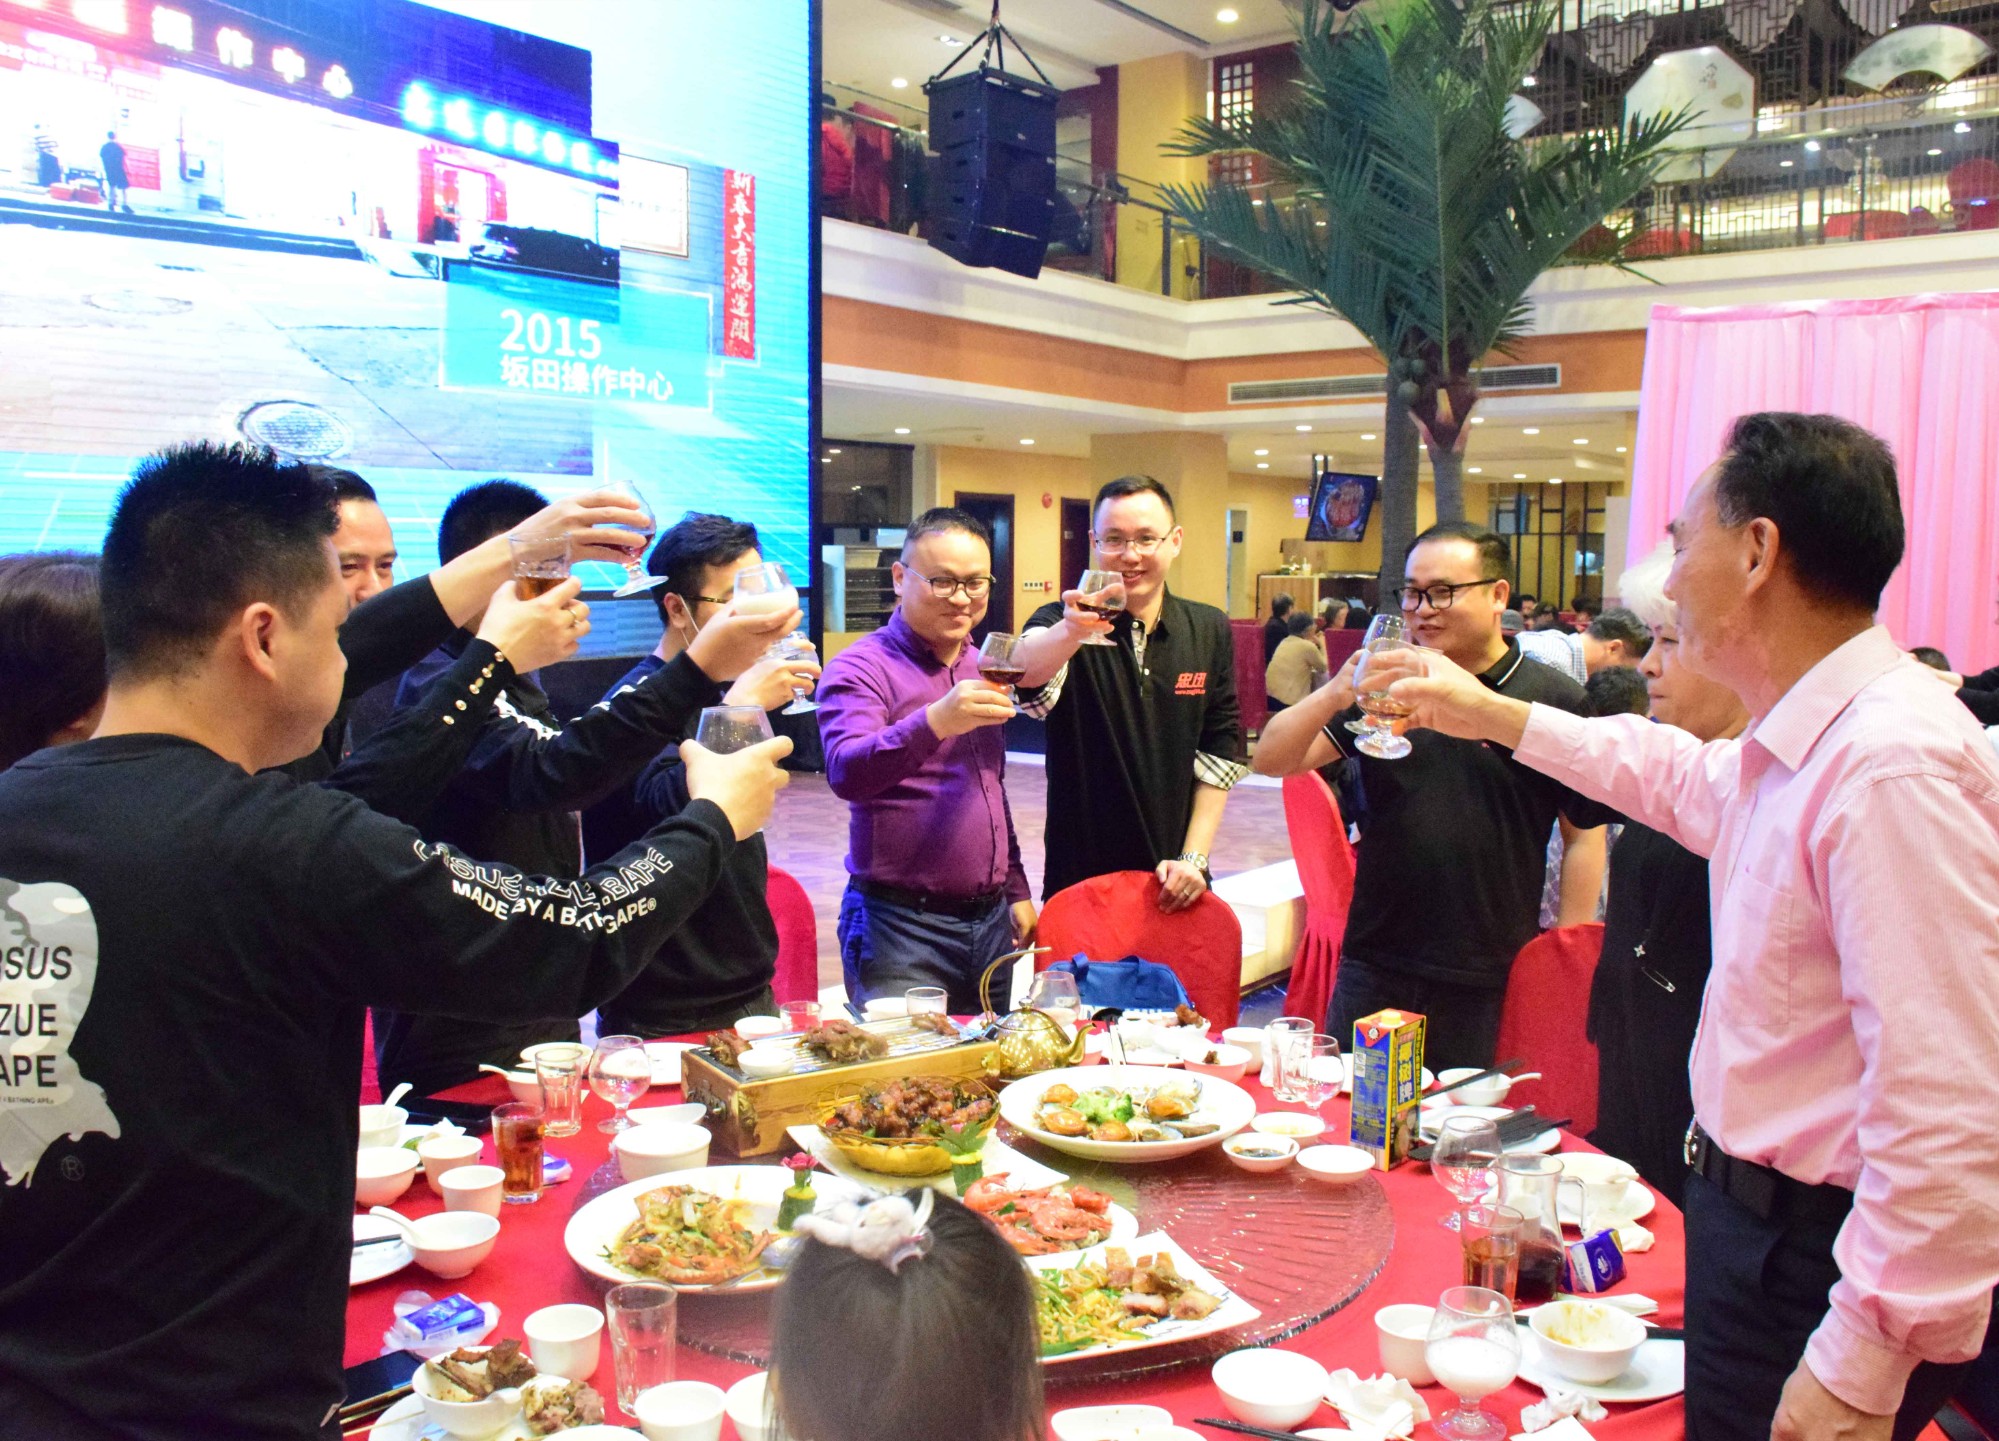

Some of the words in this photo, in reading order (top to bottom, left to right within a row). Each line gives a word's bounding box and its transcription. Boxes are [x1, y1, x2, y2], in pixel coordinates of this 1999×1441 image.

[501, 308, 602, 359] 2015
[500, 353, 674, 401] 坂田操作中心
[452, 879, 508, 920] MADE
[511, 897, 542, 916] BY
[542, 903, 555, 922] A
[0, 946, 72, 980] SUS
